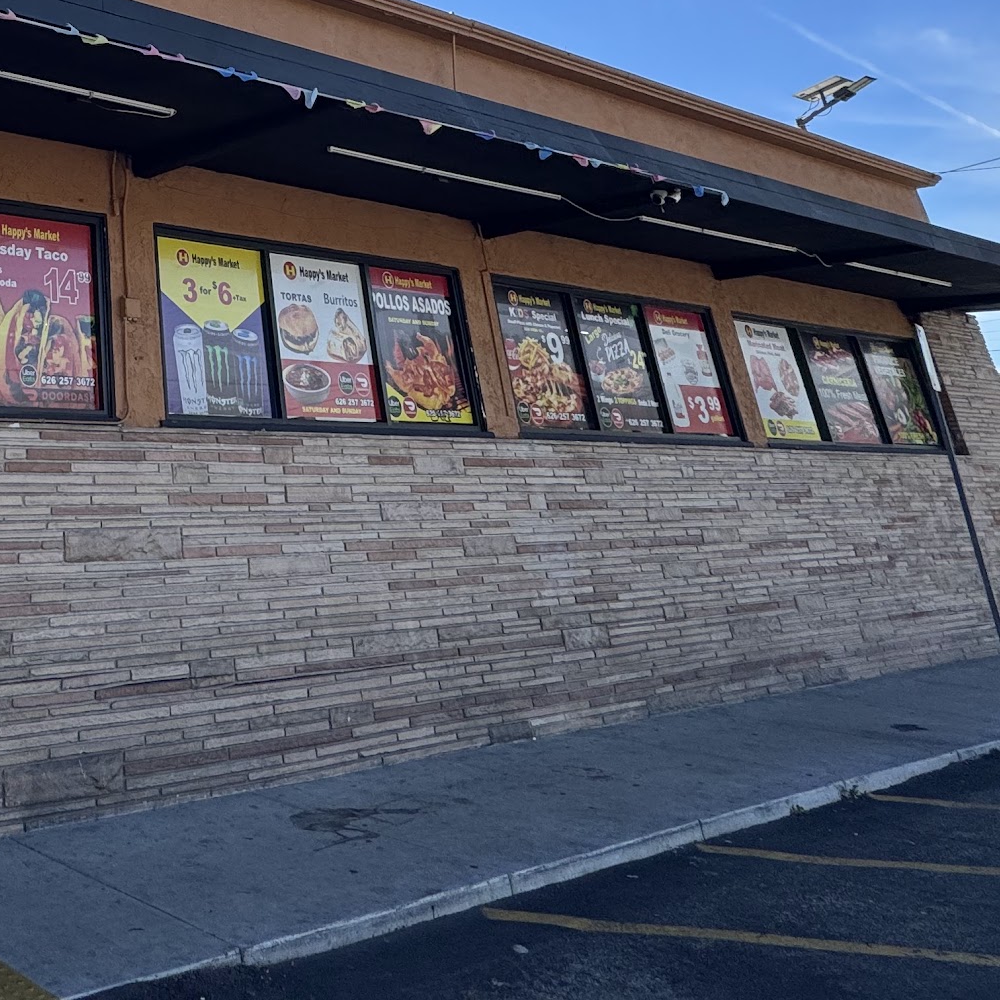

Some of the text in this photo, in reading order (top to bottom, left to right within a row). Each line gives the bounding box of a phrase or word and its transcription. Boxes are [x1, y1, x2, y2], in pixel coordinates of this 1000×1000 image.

[1, 223, 32, 241] Happy's
[33, 228, 60, 242] Market
[35, 246, 68, 262] Taco
[191, 253, 217, 268] Happy's
[218, 257, 240, 270] Market
[298, 265, 325, 282] Happy's
[326, 269, 349, 283] Market
[182, 277, 198, 303] 3
[199, 286, 211, 295] for
[280, 291, 358, 308] TORTAS Burritos
[412, 296, 452, 316] ASADOS
[531, 310, 557, 322] Special
[581, 311, 631, 326] Lunch Special
[605, 338, 630, 362] PIZZA
[41, 375, 56, 385] 626
[58, 376, 74, 386] 257
